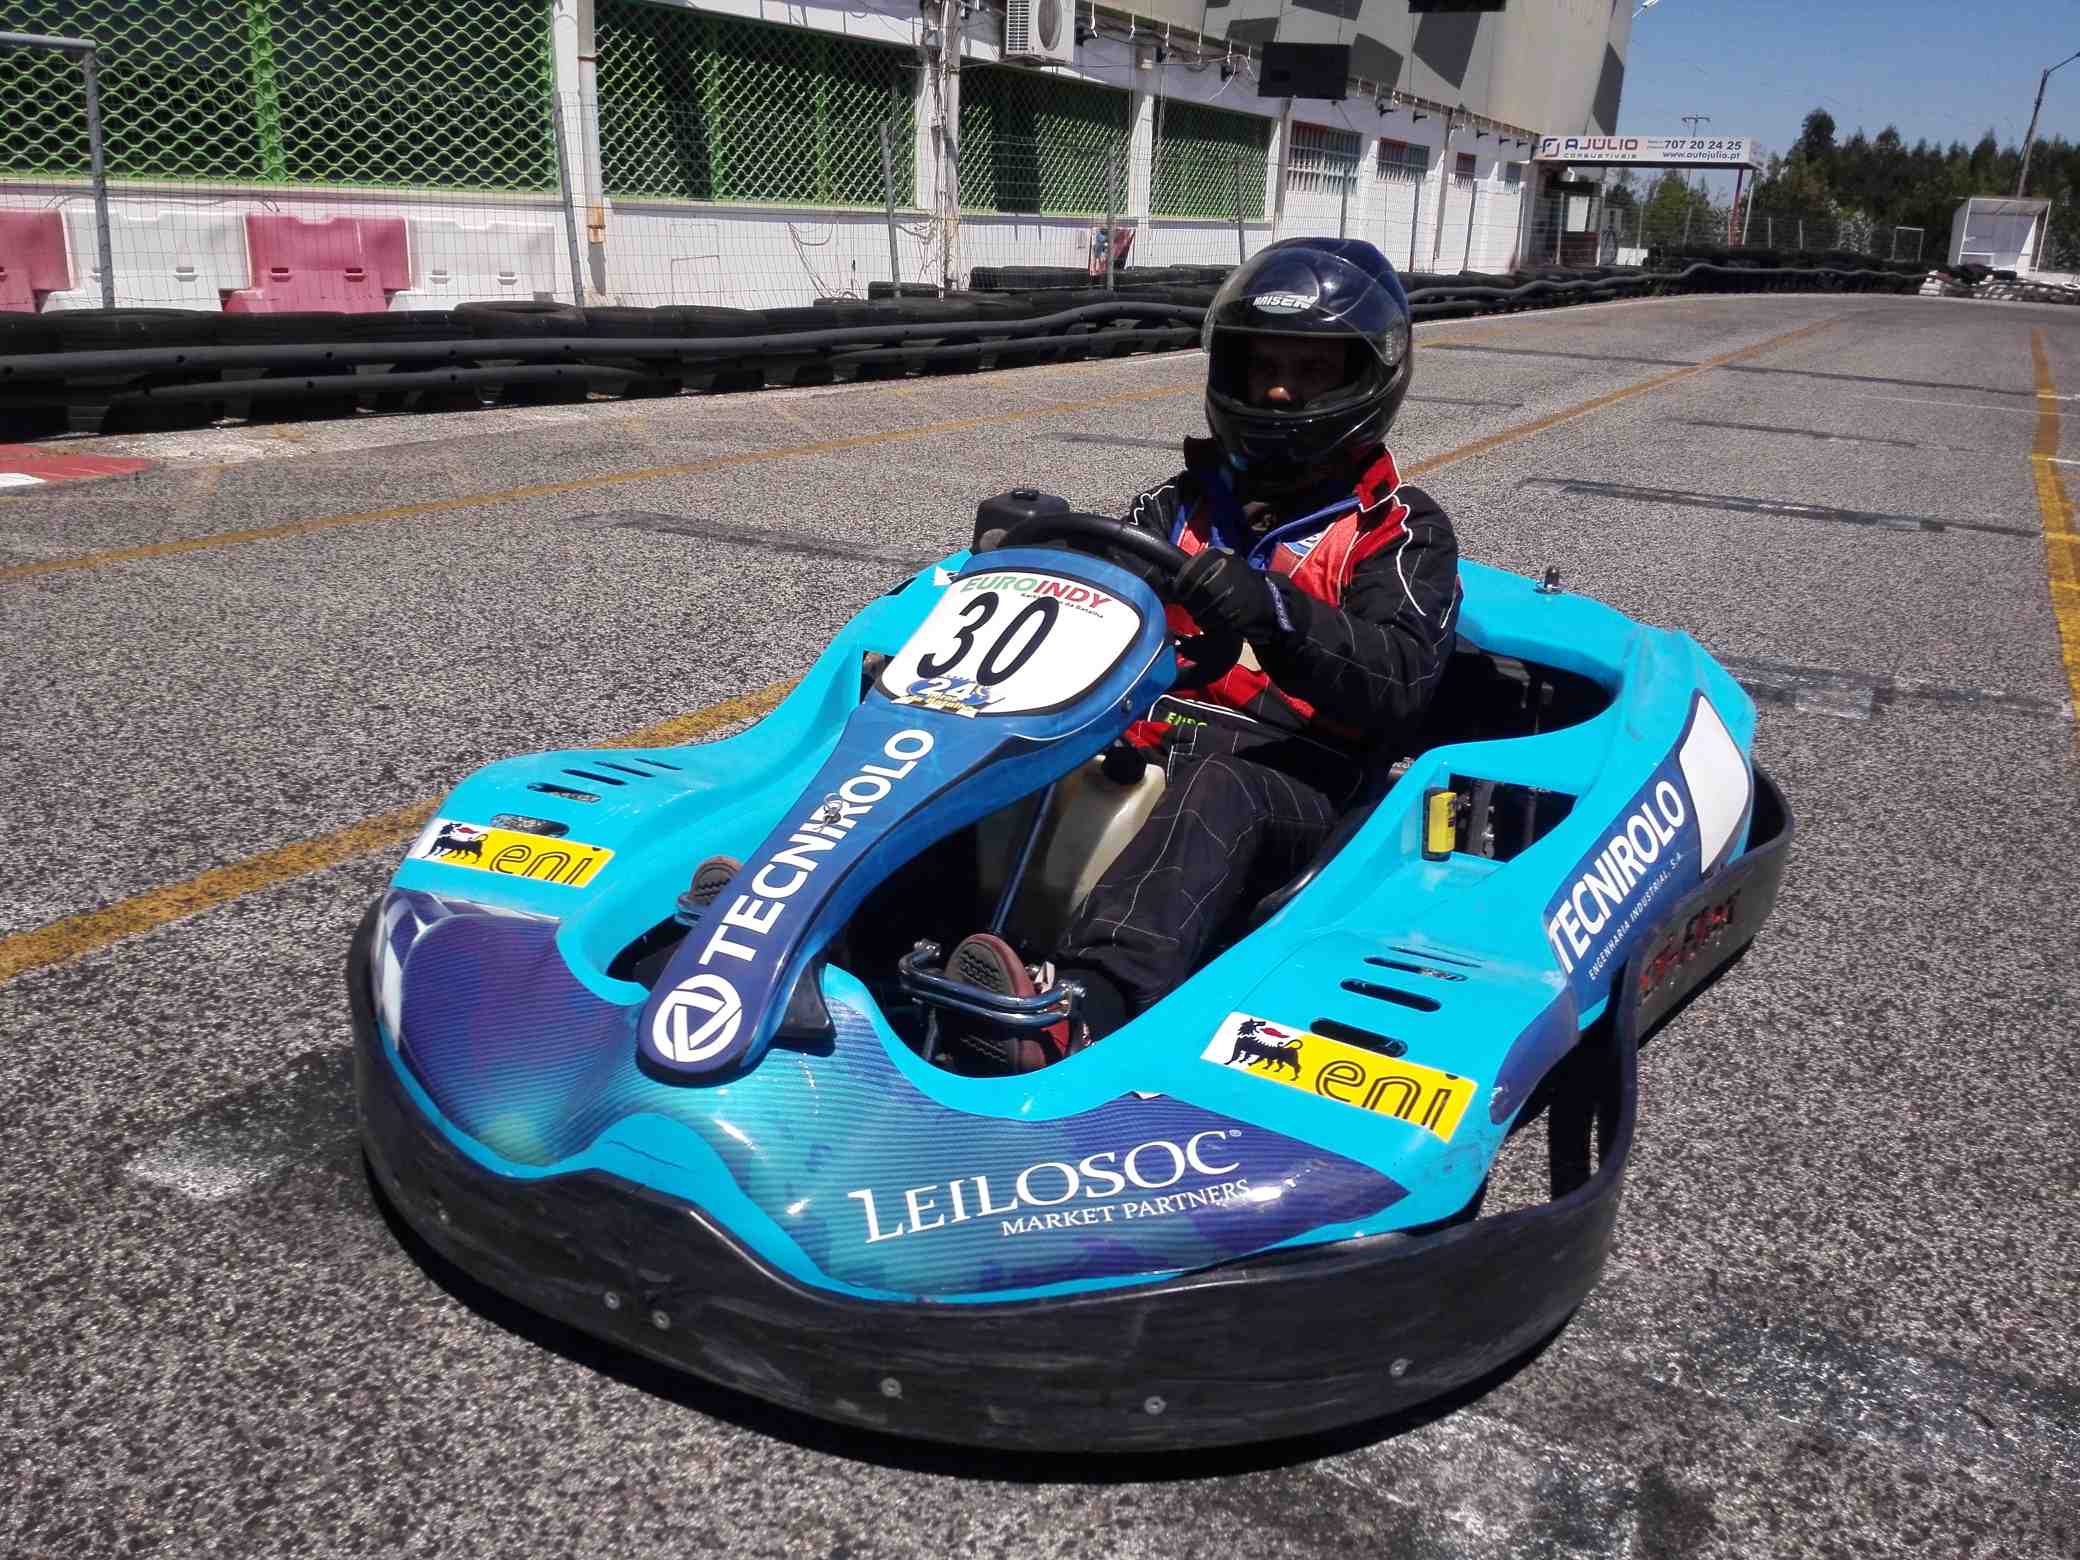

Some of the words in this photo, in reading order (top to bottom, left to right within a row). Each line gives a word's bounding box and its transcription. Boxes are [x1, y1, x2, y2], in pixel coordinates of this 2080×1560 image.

[1664, 140, 1686, 149] 707
[1689, 140, 1705, 150] 20
[1708, 140, 1723, 150] 24
[1726, 141, 1742, 151] 25
[960, 576, 1113, 611] EUROINDY
[916, 591, 1060, 686] 30
[489, 844, 602, 885] eni
[698, 729, 935, 965] TECNIROLO
[1547, 780, 1685, 974] TECNIROLO
[1587, 919, 1631, 981] ENGENHARIA
[1315, 1060, 1459, 1131] eni
[1001, 1206, 1115, 1236] MARKET
[1122, 1179, 1250, 1220] PARTNERS
